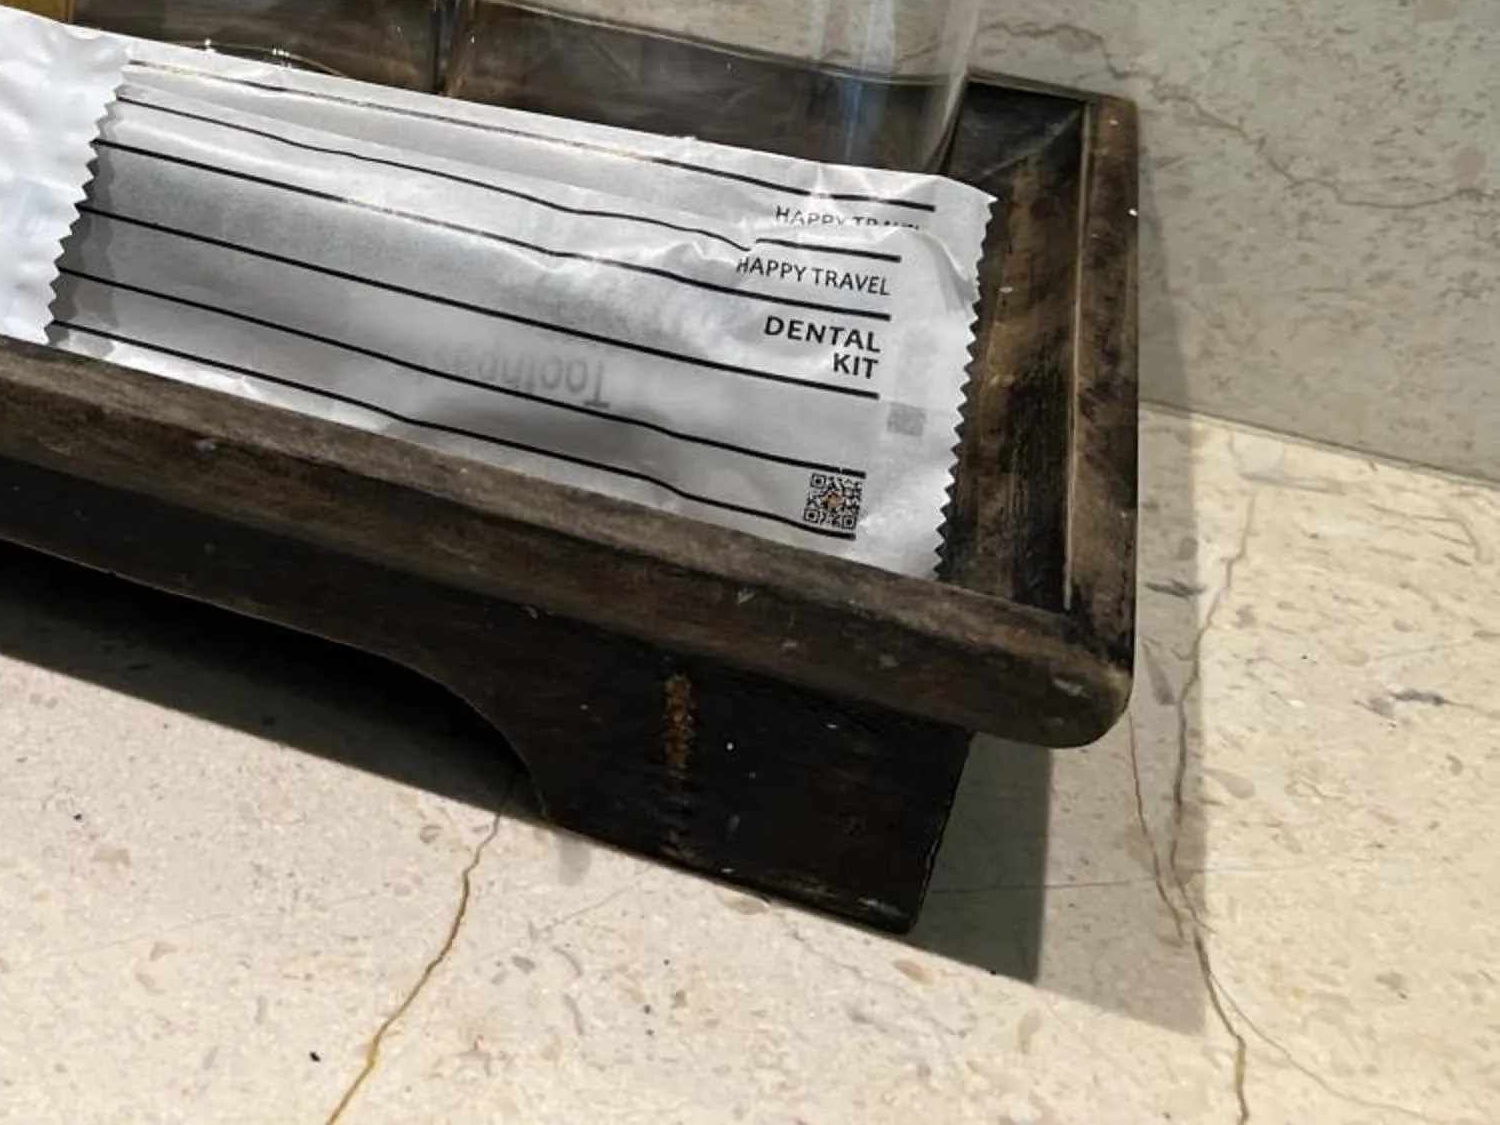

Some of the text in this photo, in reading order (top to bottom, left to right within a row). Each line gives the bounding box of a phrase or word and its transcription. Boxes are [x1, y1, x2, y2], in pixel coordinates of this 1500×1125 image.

[736, 256, 891, 296] HAPPY TRAVEL
[764, 315, 881, 354] DENTAL
[833, 352, 879, 379] KIT
